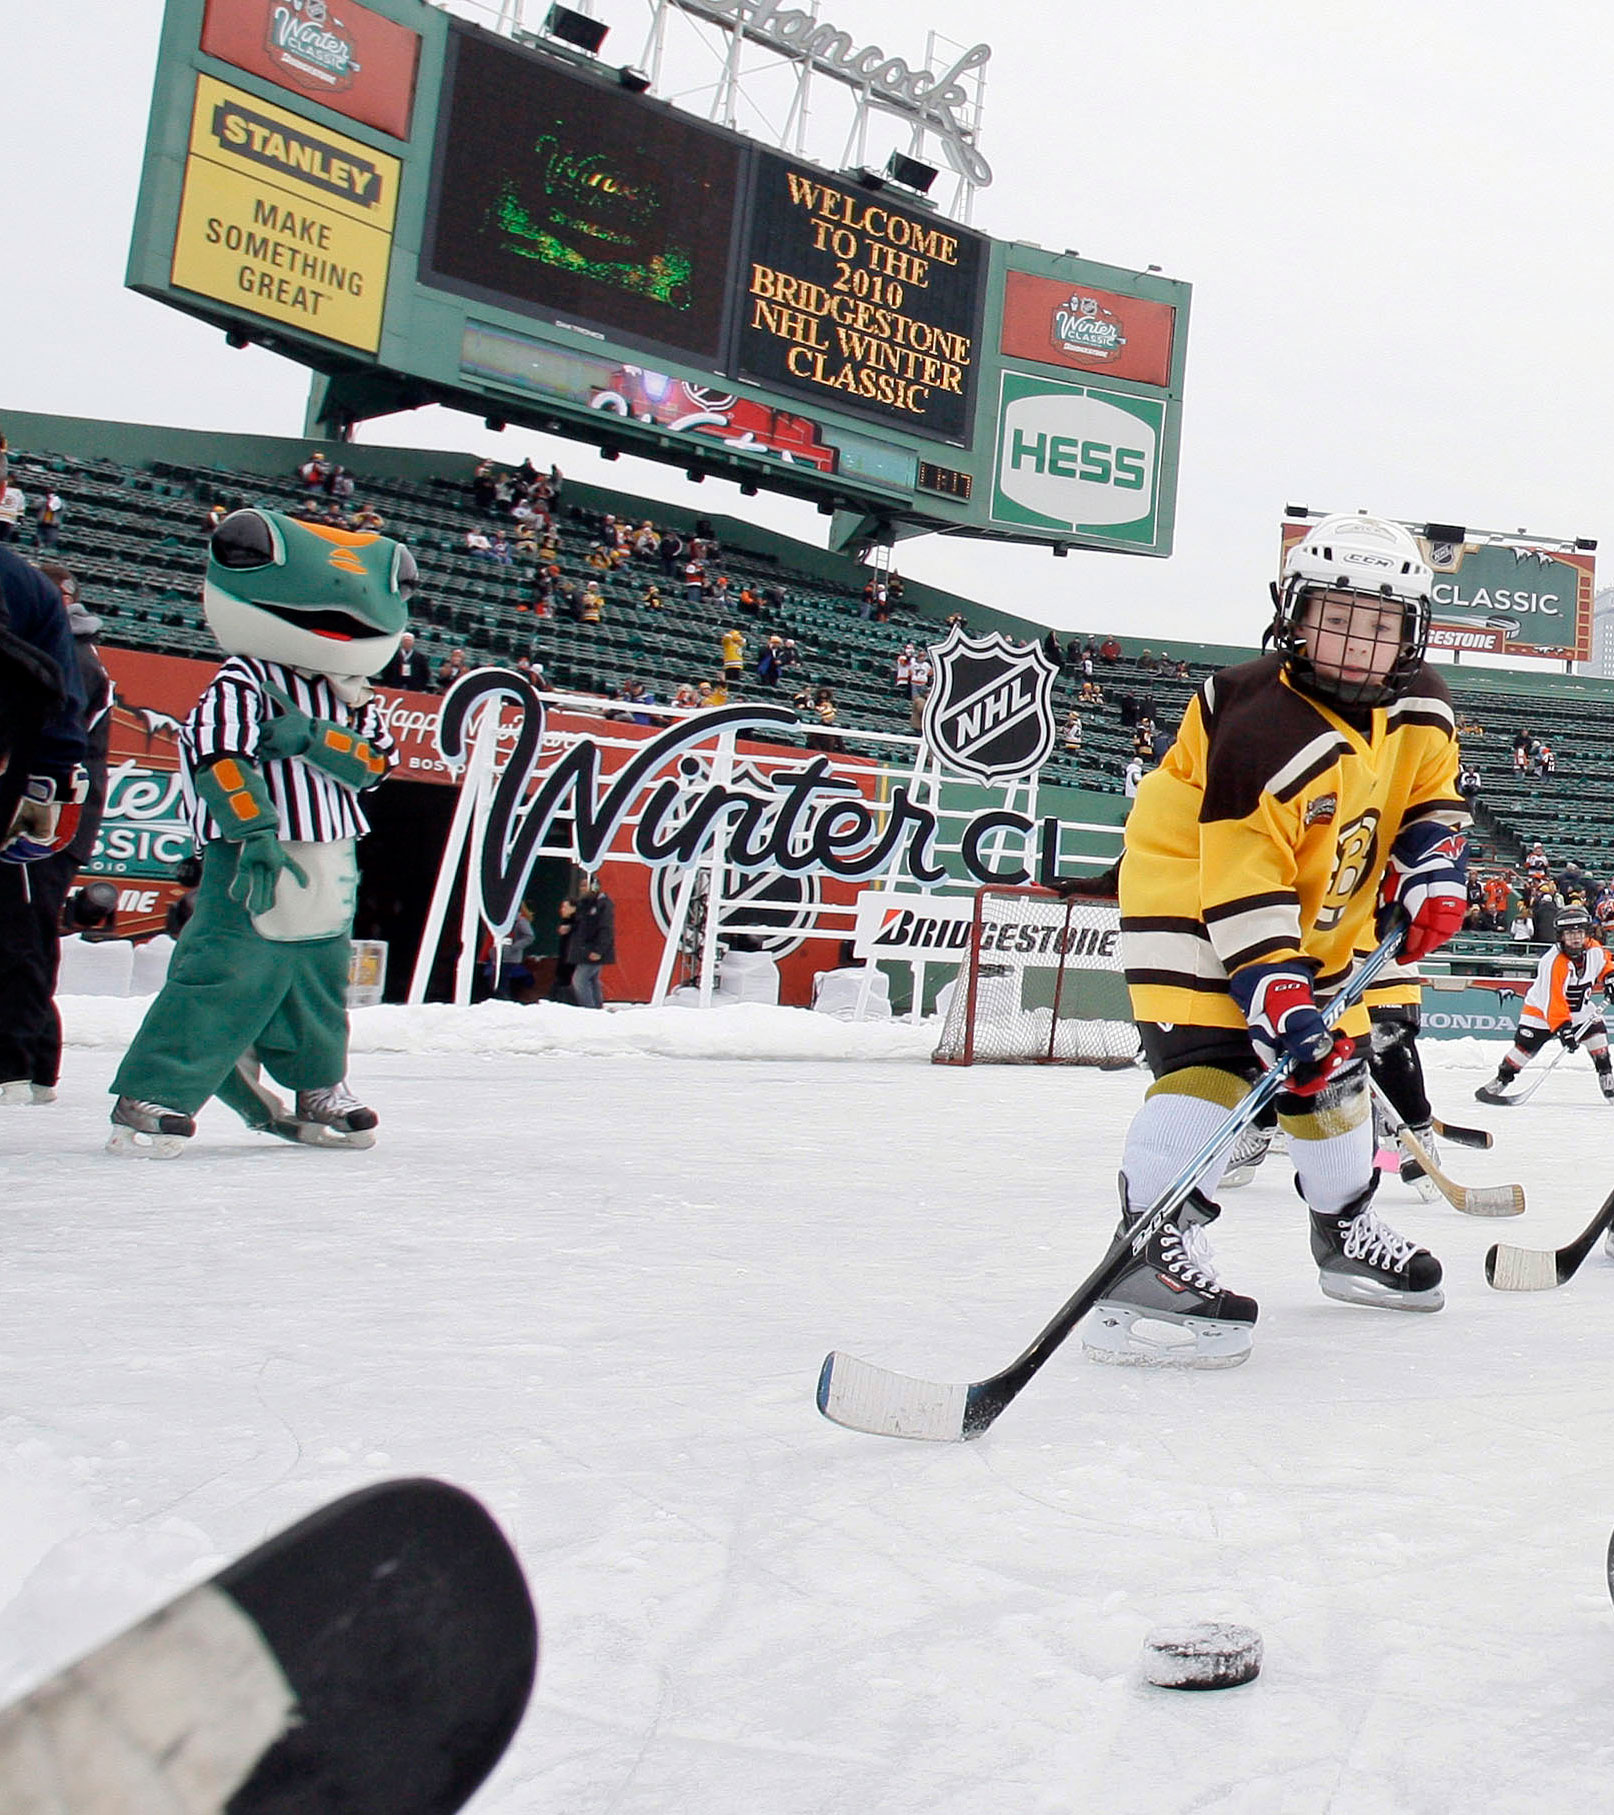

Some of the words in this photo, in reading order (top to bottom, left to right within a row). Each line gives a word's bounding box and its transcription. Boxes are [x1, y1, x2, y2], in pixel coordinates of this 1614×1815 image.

[275, 7, 350, 59] Winter
[222, 113, 375, 198] STANLEY
[254, 198, 331, 250] MAKE
[786, 172, 958, 266] WELCOME
[206, 217, 363, 297] SOMETHING
[810, 217, 857, 260] TO
[865, 238, 929, 288] THE
[239, 264, 328, 316] GREAT
[833, 261, 904, 309] 2010
[749, 263, 971, 366] BRIDGESTONE
[1056, 311, 1117, 339] Winter
[1067, 330, 1115, 346] CLASSIC
[751, 299, 829, 351] NHL
[836, 326, 963, 395] WINTER
[786, 346, 929, 414] CLASSIC
[1011, 428, 1146, 491] HESS
[1348, 553, 1390, 568] CCM
[1432, 584, 1559, 616] CLASSIC
[1428, 630, 1496, 650] GESTONE
[371, 694, 440, 749] Happ
[956, 677, 1032, 748] NHL
[439, 667, 948, 933] Winter
[78, 861, 127, 872] 010
[872, 909, 1122, 957] BRIDGESTONE
